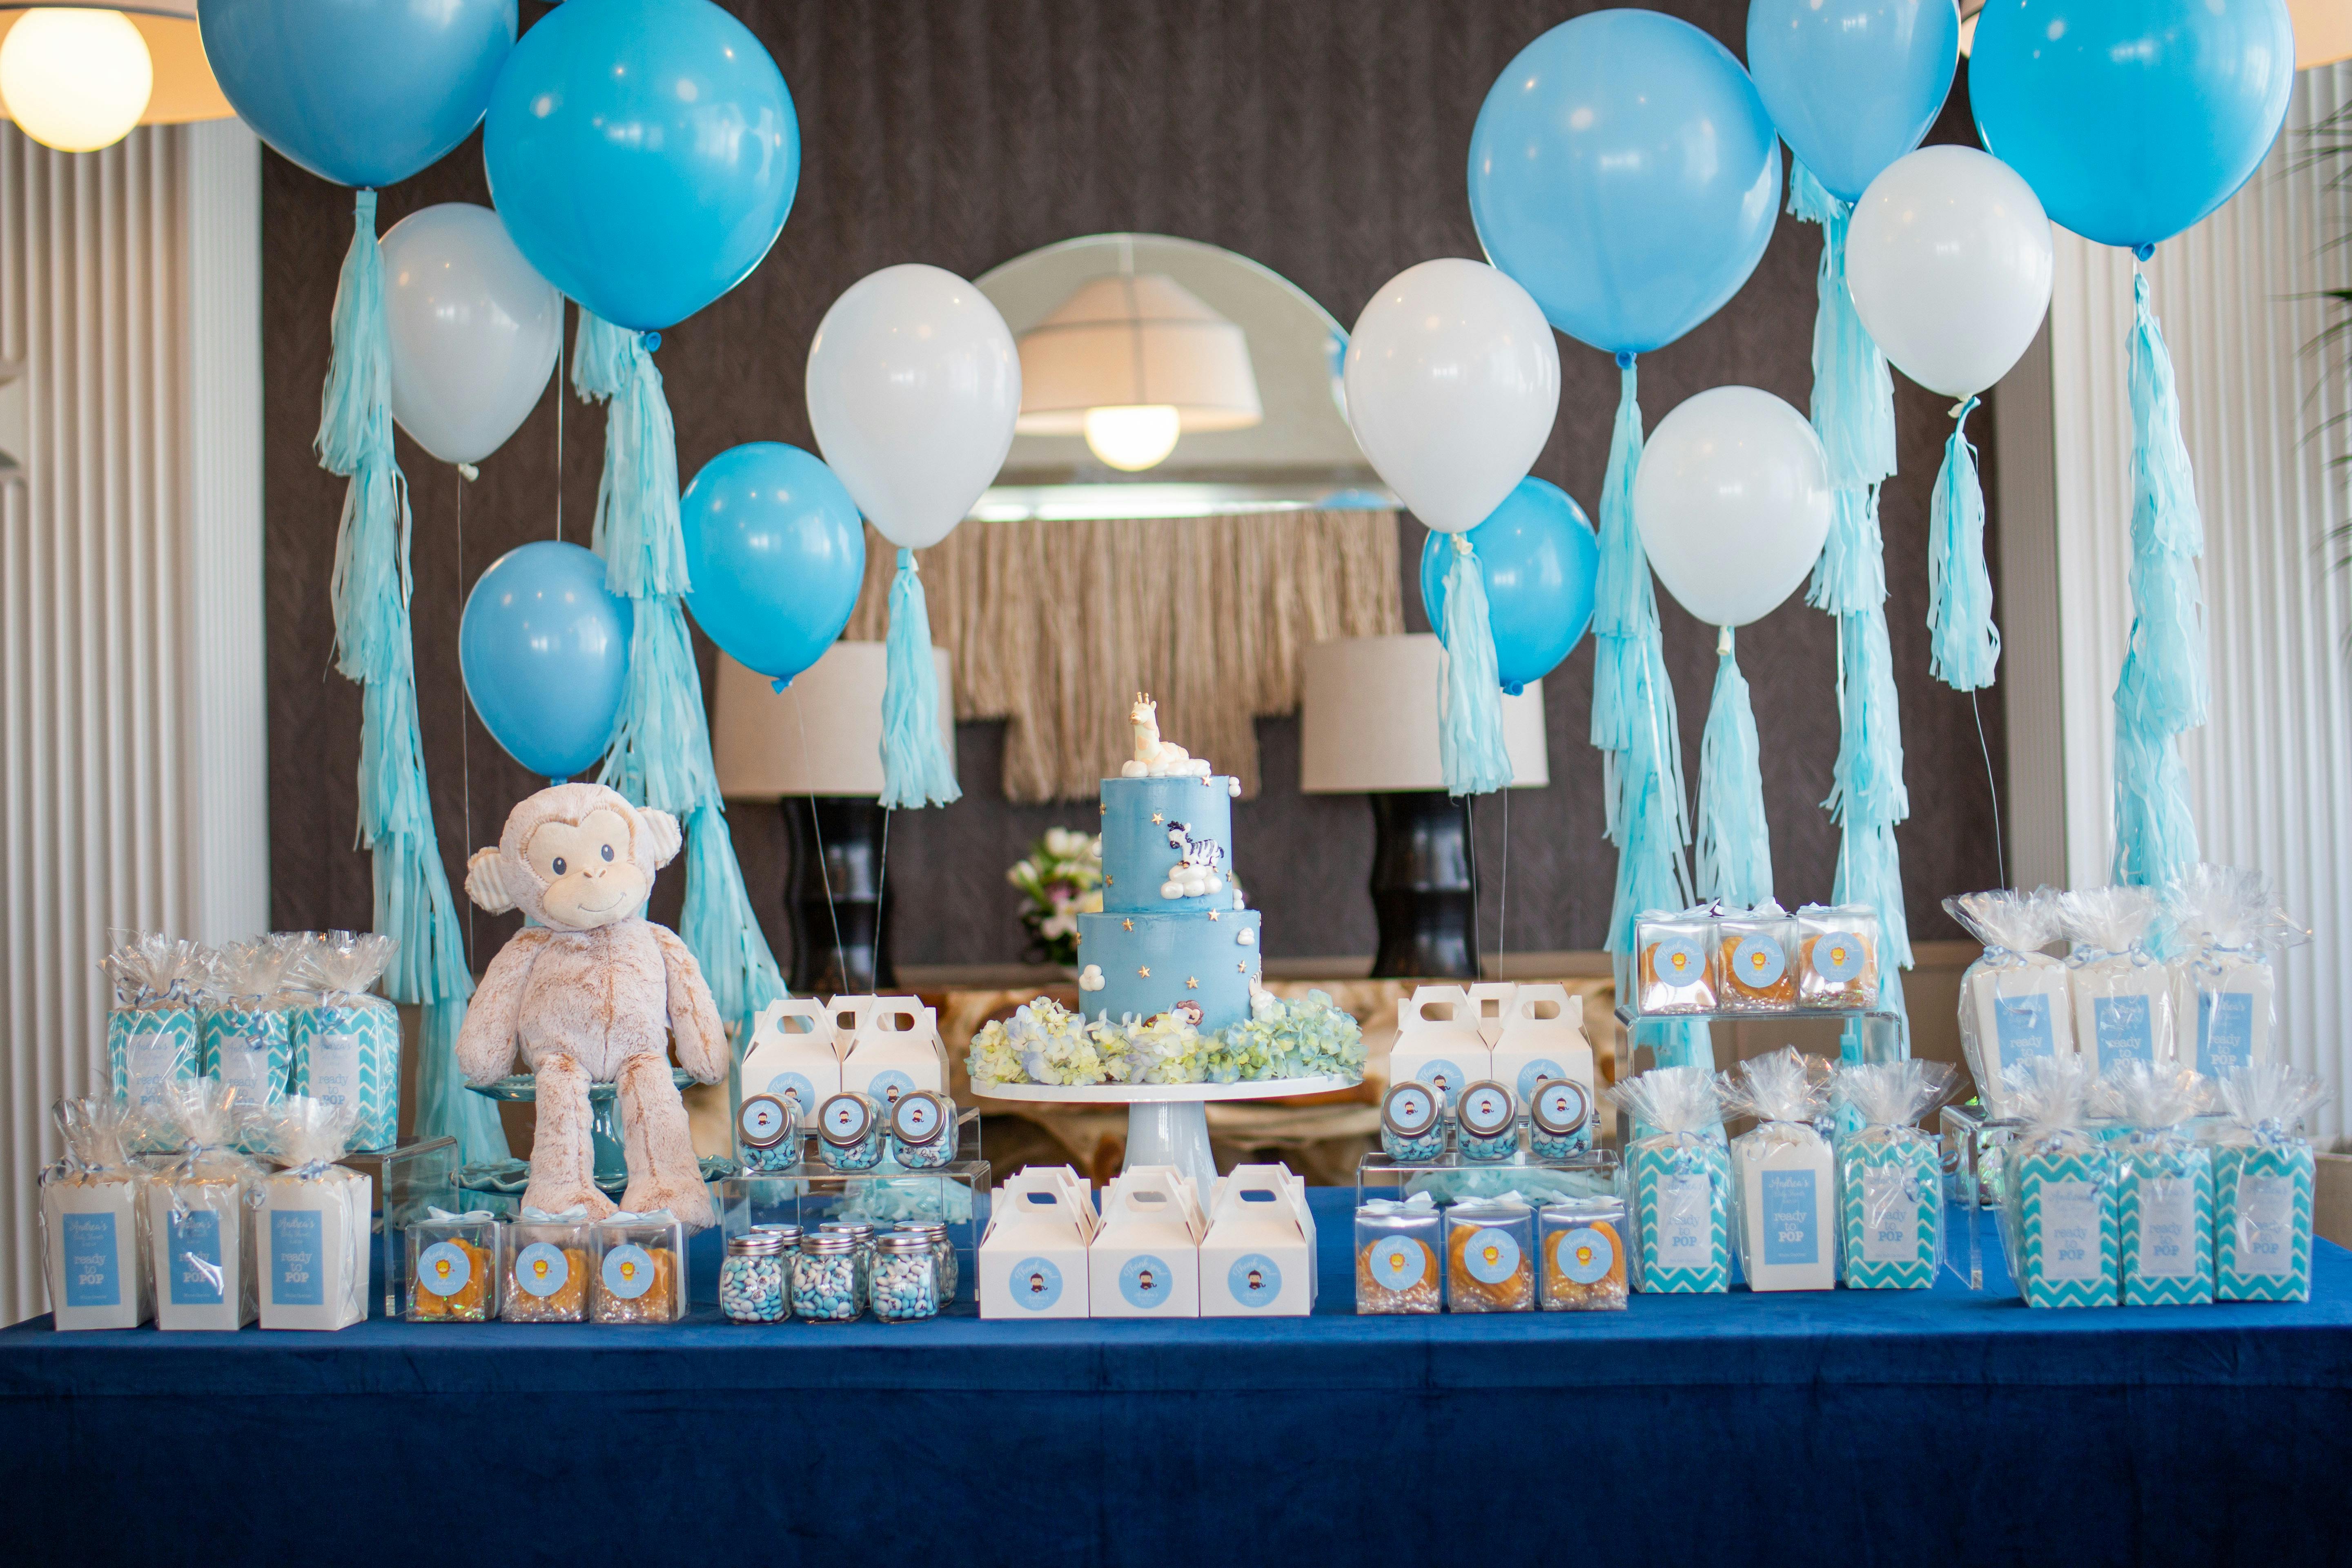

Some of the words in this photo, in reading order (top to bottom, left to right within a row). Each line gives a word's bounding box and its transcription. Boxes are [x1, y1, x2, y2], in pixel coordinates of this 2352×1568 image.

[1659, 940, 1681, 960] Thank
[1740, 940, 1764, 958] Thank
[1817, 935, 1842, 953] Thank
[2010, 1036, 2042, 1048] ready
[2210, 1033, 2241, 1047] eady
[2119, 1048, 2132, 1057] to
[2218, 1045, 2230, 1054] to
[2211, 1054, 2237, 1065] POP
[1419, 1063, 1441, 1082] Thank
[1523, 1062, 1546, 1081] Thank
[228, 1077, 258, 1089] ready
[318, 1075, 349, 1086] ready
[771, 1076, 793, 1093] Thank
[873, 1074, 895, 1092] Thank
[321, 1095, 345, 1105] POP
[1768, 1176, 1810, 1189] Andrea's
[1773, 1211, 1807, 1223] ready
[1678, 1227, 1690, 1235] to
[1785, 1223, 1796, 1231] to
[1884, 1221, 1896, 1229] to
[2149, 1222, 2183, 1236] ready
[1778, 1232, 1804, 1242] POP
[1878, 1231, 1903, 1241] POP
[2054, 1227, 2087, 1240] ready
[1470, 1233, 1493, 1254] Thank
[1563, 1234, 1588, 1254] Thank
[1672, 1236, 1697, 1247] POP
[1376, 1240, 1402, 1258] Thank
[2153, 1245, 2180, 1256] POP
[2253, 1243, 2279, 1254] POP
[74, 1253, 107, 1265] ready
[281, 1252, 313, 1263] ready
[423, 1247, 445, 1267] Thank
[520, 1247, 543, 1266] Thank
[608, 1249, 631, 1268] Thank
[2058, 1249, 2085, 1261] POP
[85, 1265, 96, 1274] to
[291, 1263, 302, 1271] to
[1015, 1261, 1040, 1281] Thank
[1123, 1258, 1148, 1278] Thank
[1233, 1258, 1257, 1277] Thank
[78, 1274, 104, 1285] POP
[285, 1272, 310, 1283] POP
